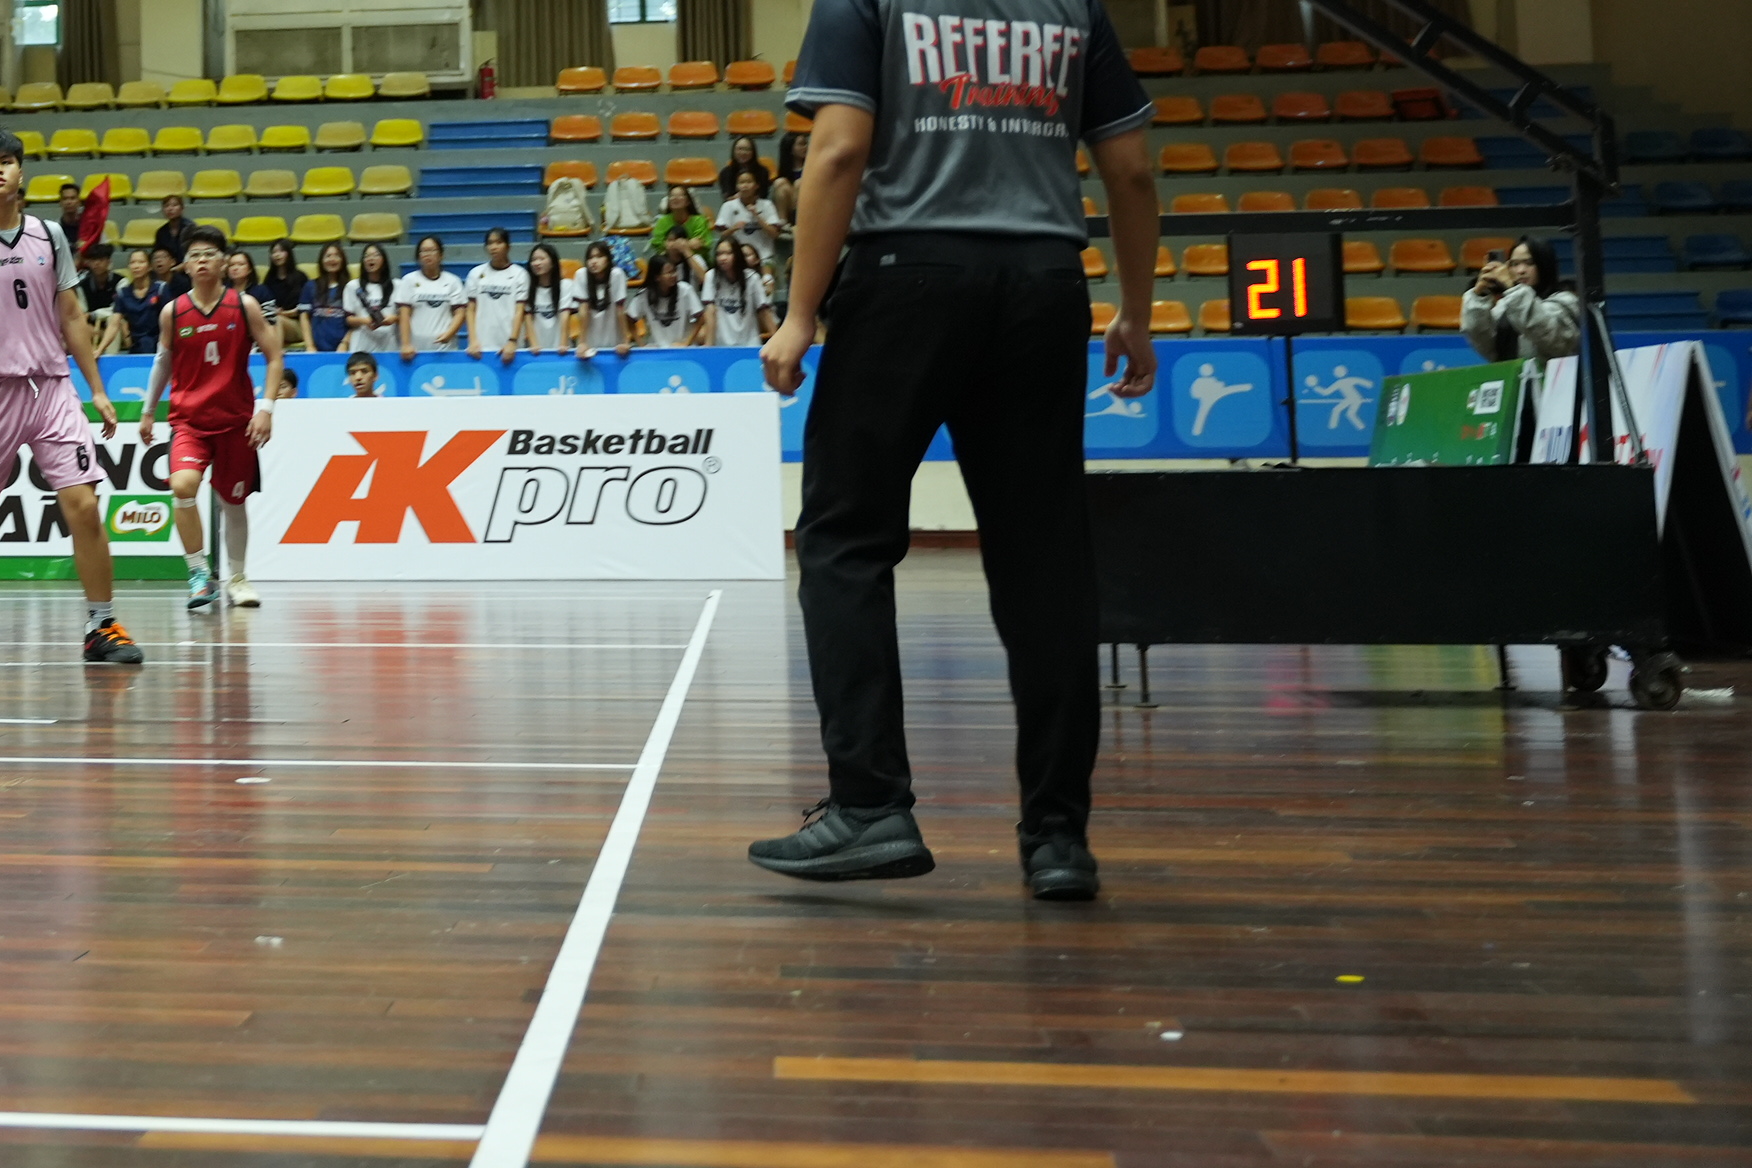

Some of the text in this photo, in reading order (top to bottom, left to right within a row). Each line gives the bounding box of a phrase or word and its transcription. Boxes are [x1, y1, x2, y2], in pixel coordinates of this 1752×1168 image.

[13, 278, 28, 310] 6
[1246, 257, 1308, 320] 21
[204, 340, 221, 365] 4
[506, 428, 715, 456] Basketball
[76, 445, 90, 472] 6
[231, 480, 246, 499] 4
[278, 429, 509, 544] AK
[483, 465, 708, 544] pro
[121, 510, 162, 524] MILO
